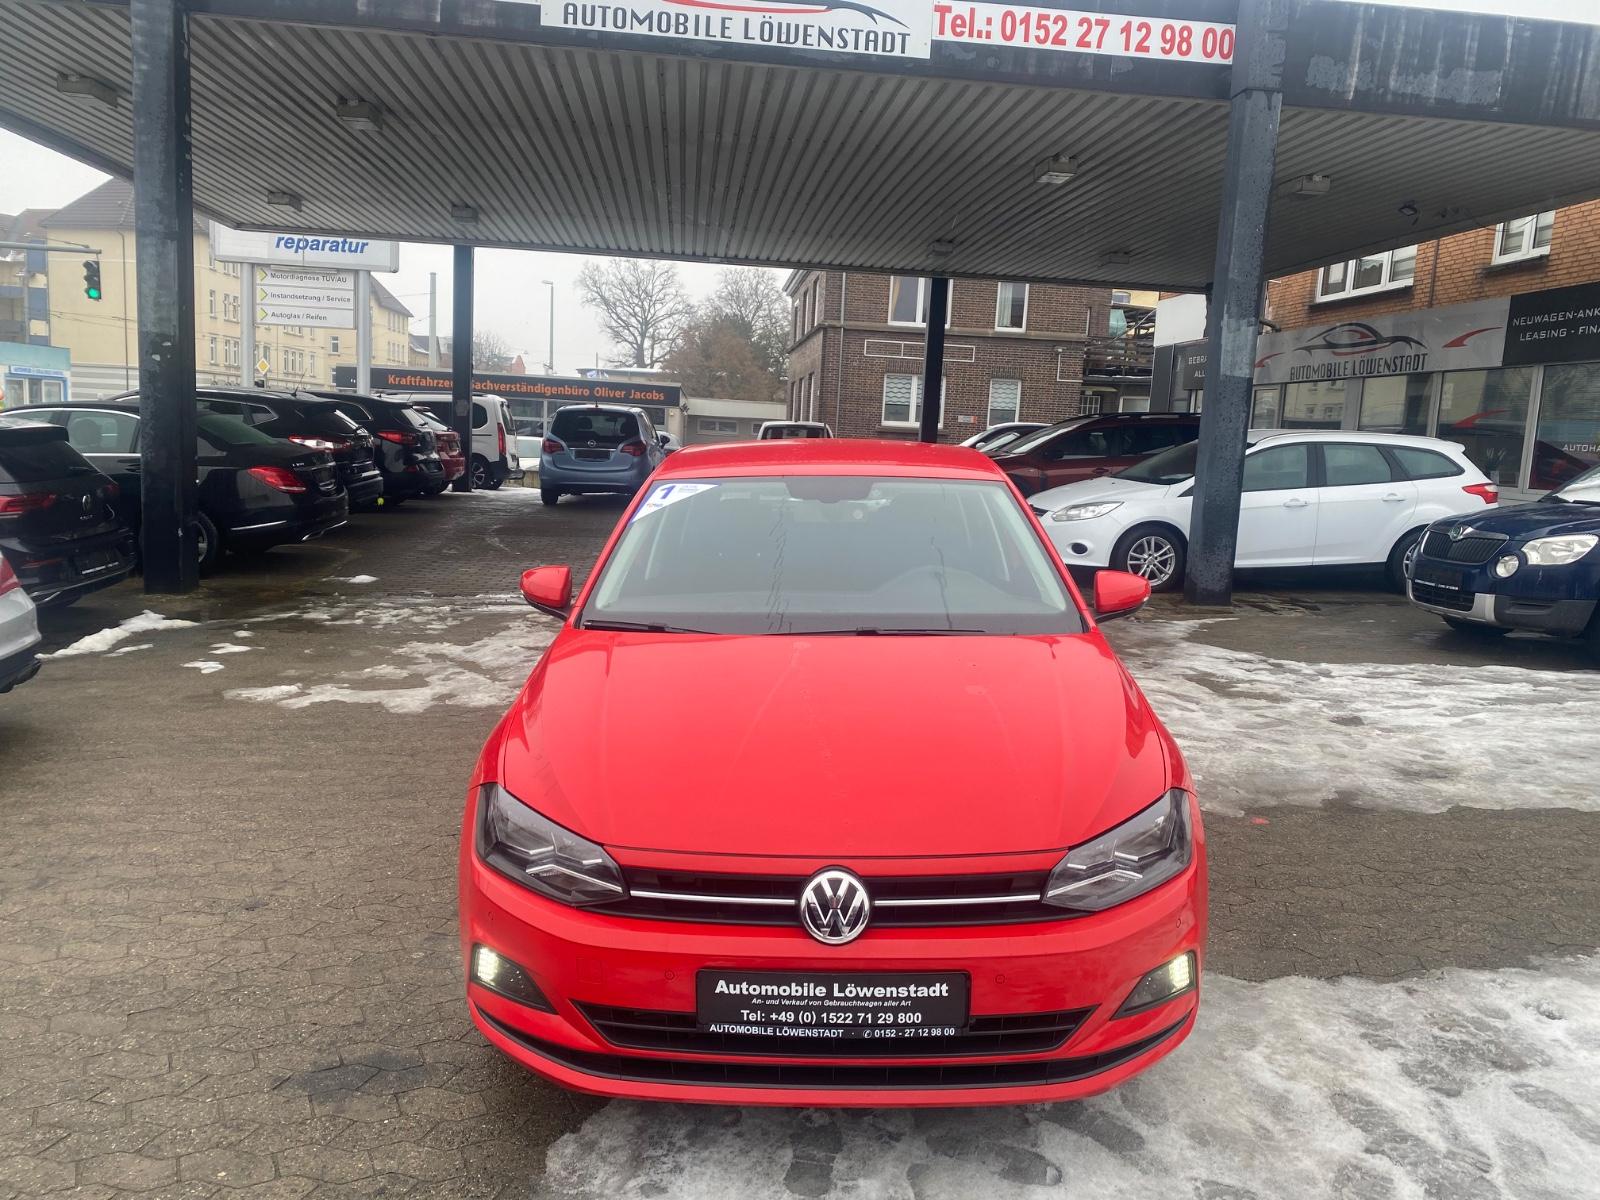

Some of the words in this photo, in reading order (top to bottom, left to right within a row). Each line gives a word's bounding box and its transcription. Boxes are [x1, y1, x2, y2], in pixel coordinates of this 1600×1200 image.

[563, 2, 733, 39] AUTOMOBILE
[743, 15, 911, 54] LÖWENSTADT
[934, 5, 992, 40] Tel.:
[1000, 9, 1068, 46] 0152
[1076, 16, 1111, 50] 27
[1119, 20, 1151, 53] 12
[1160, 23, 1193, 57] 98
[1201, 27, 1235, 60] 00
[275, 236, 369, 254] reparatur
[270, 272, 320, 282] Motordiagnose
[270, 292, 321, 302] Instandsetzung
[271, 311, 301, 320] Autoglas
[305, 313, 327, 321] Reifen
[1519, 328, 1567, 341] LEASING
[1290, 361, 1349, 381] AUTOMOBILE
[1352, 353, 1428, 376] LÖWENSTADT
[388, 374, 453, 388] Kraftfahrze
[594, 386, 626, 398] Oliver
[629, 388, 664, 400] Jacobs
[715, 980, 827, 997] Automobile
[833, 983, 949, 998] Löwenstadt
[823, 1000, 882, 1008] Gebrauchtwagen
[740, 1010, 765, 1022] Tel:
[770, 1011, 795, 1022] +49
[799, 1011, 817, 1024] (0)
[821, 1012, 853, 1024] 1522
[857, 1013, 872, 1024] 71
[877, 1013, 894, 1024] 29
[897, 1012, 922, 1024] 800
[709, 1024, 774, 1035] AUTOMOBILE
[776, 1027, 844, 1038] LÖWENSTADT
[904, 1029, 915, 1037] 27
[918, 1028, 929, 1037] 12
[931, 1028, 942, 1036] 98
[944, 1027, 955, 1036] 00
